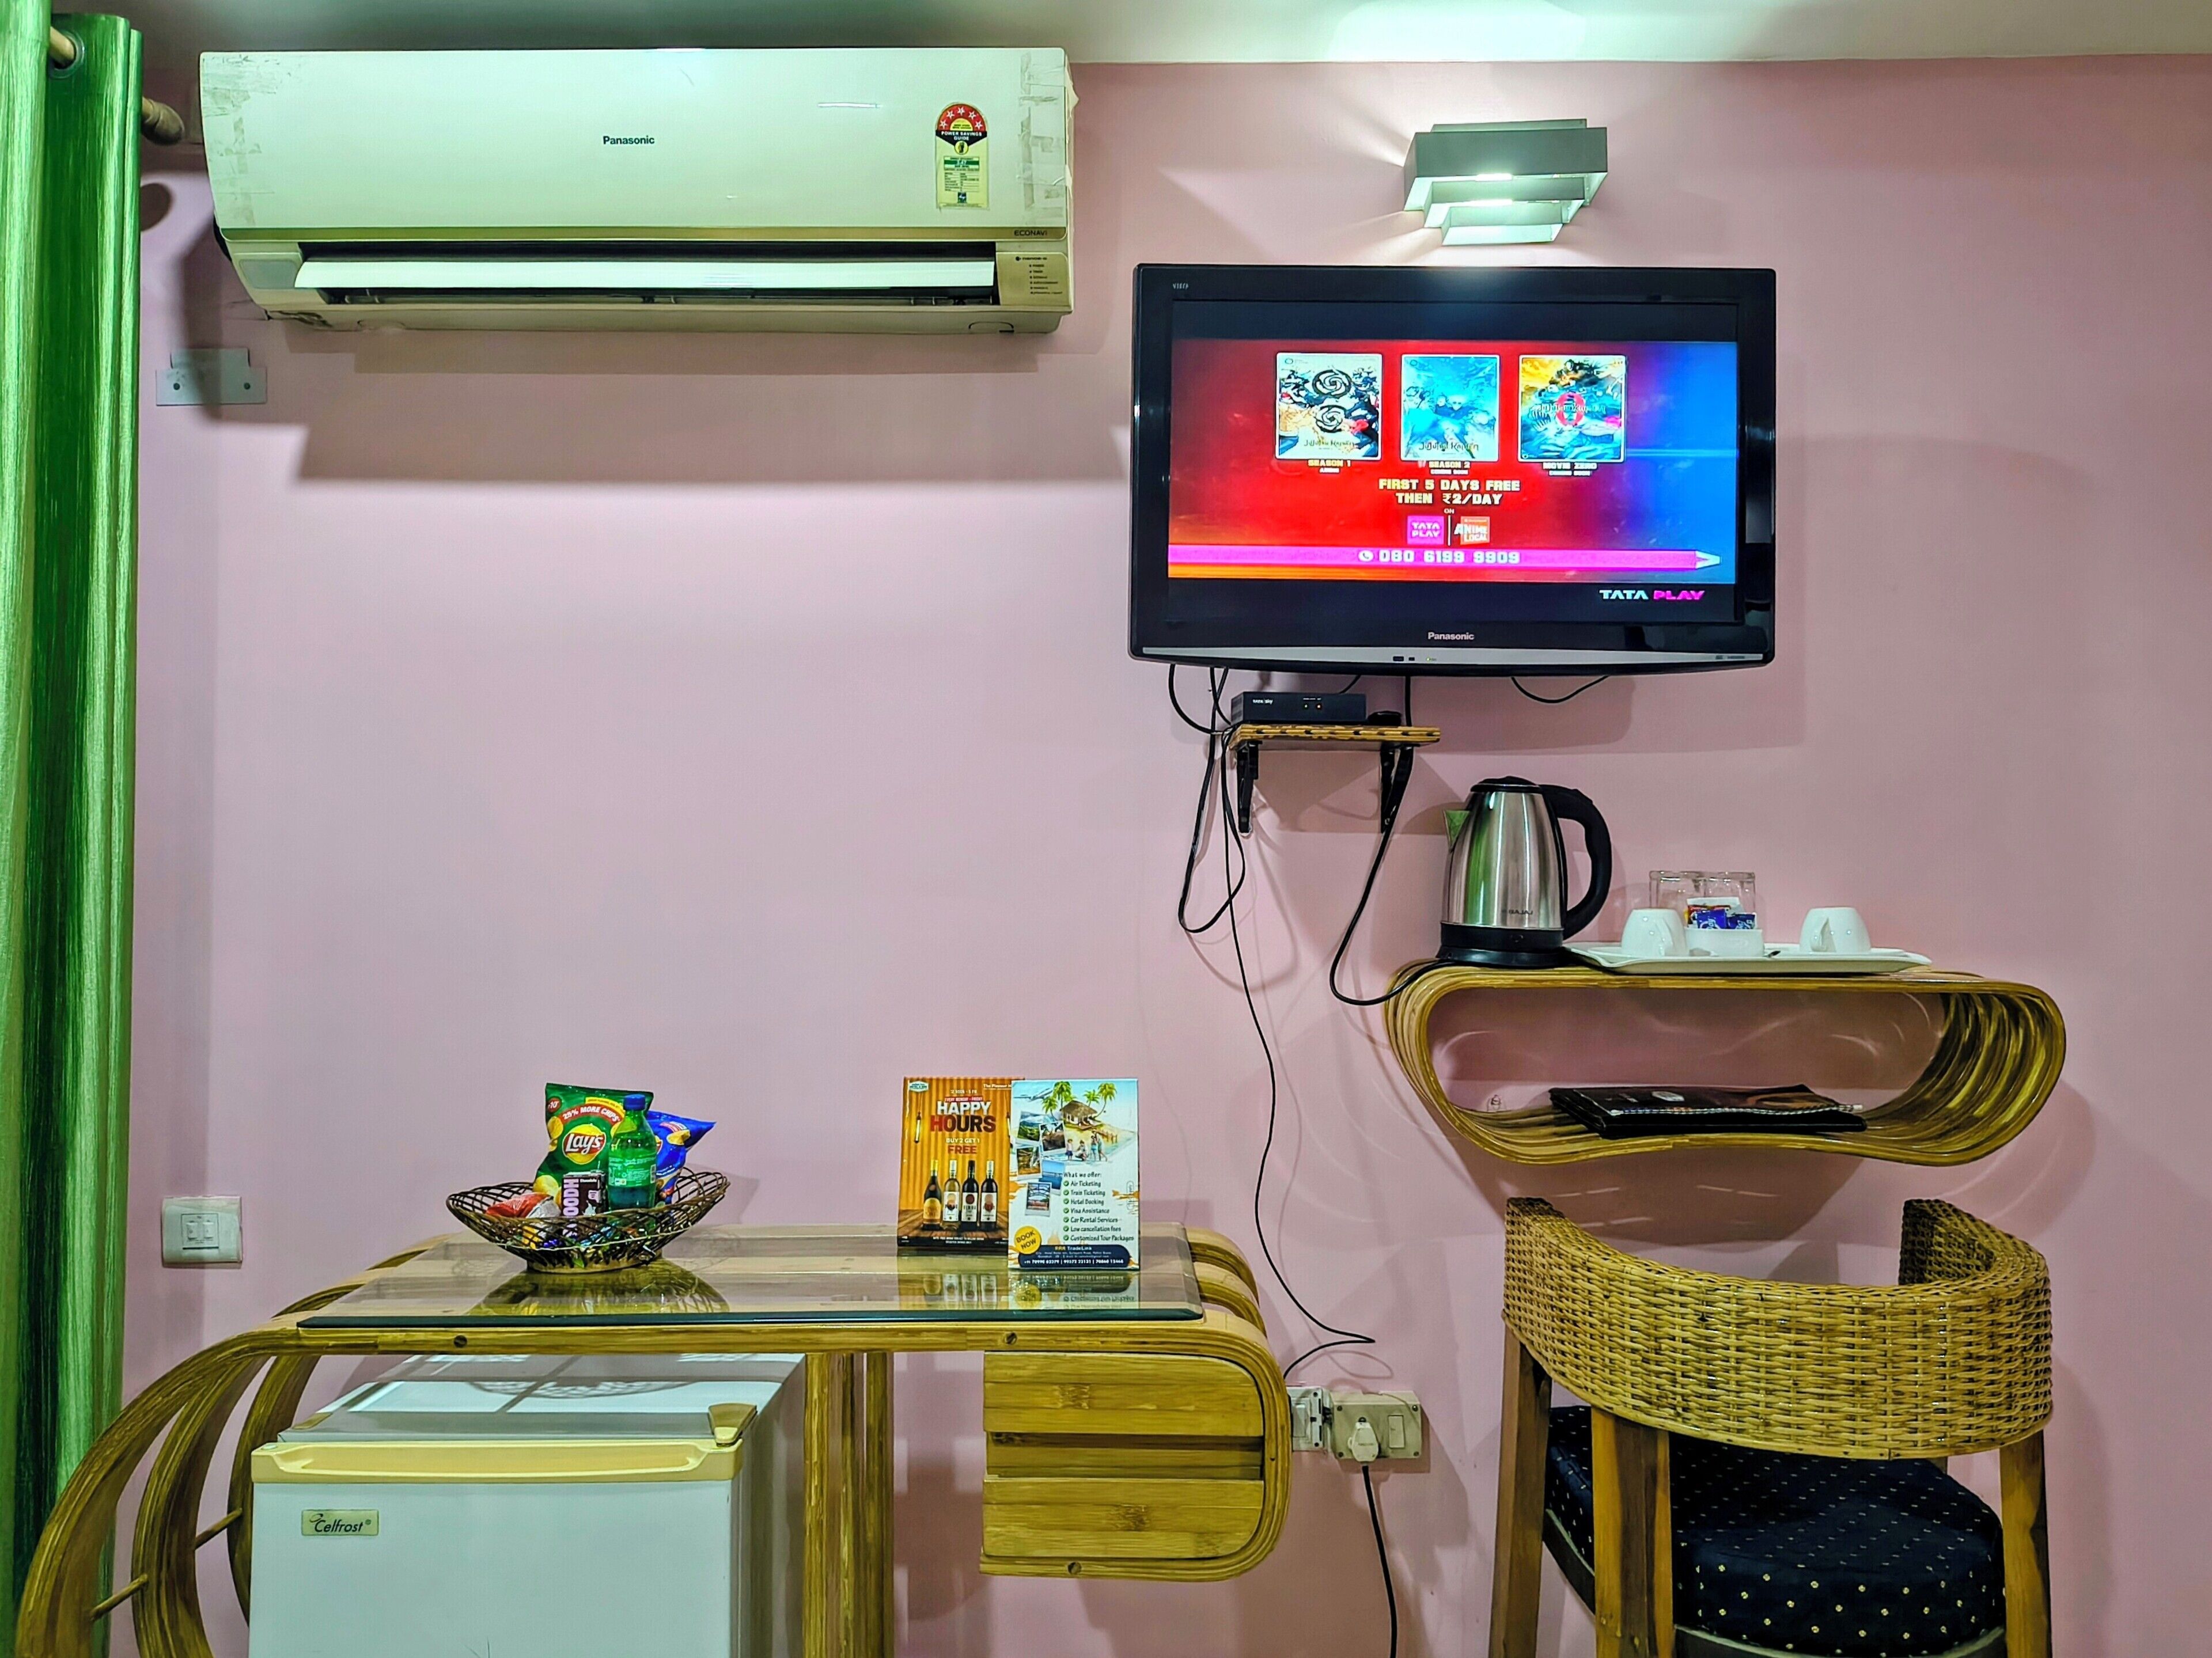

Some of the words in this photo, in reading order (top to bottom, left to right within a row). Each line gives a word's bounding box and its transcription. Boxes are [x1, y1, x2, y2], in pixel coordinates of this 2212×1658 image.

[603, 135, 655, 145] Panasonic
[1378, 479, 1419, 490] FIRST
[1425, 479, 1434, 490] 5
[1440, 479, 1480, 491] DAYS
[1485, 480, 1521, 491] FREE
[1395, 492, 1433, 504] THEN
[1442, 493, 1503, 505] ₹2/DAY
[1411, 522, 1441, 530] TATA
[1378, 549, 1415, 563] 080
[1423, 550, 1465, 563] 6199
[1473, 551, 1520, 564] 9909
[1599, 590, 1649, 600] TATA
[1653, 590, 1705, 600] PLAY
[1427, 632, 1475, 640] Panasonic
[562, 1108, 579, 1120] 25%
[580, 1106, 601, 1114] MORE
[937, 1101, 991, 1116] HAPPY
[930, 1114, 996, 1133] HOURS
[565, 1133, 603, 1155] Lay's
[948, 1145, 977, 1154] FREE
[1016, 1230, 1035, 1243] BOOK
[1021, 1238, 1036, 1250] NOW
[314, 1519, 363, 1533] Celfrost
